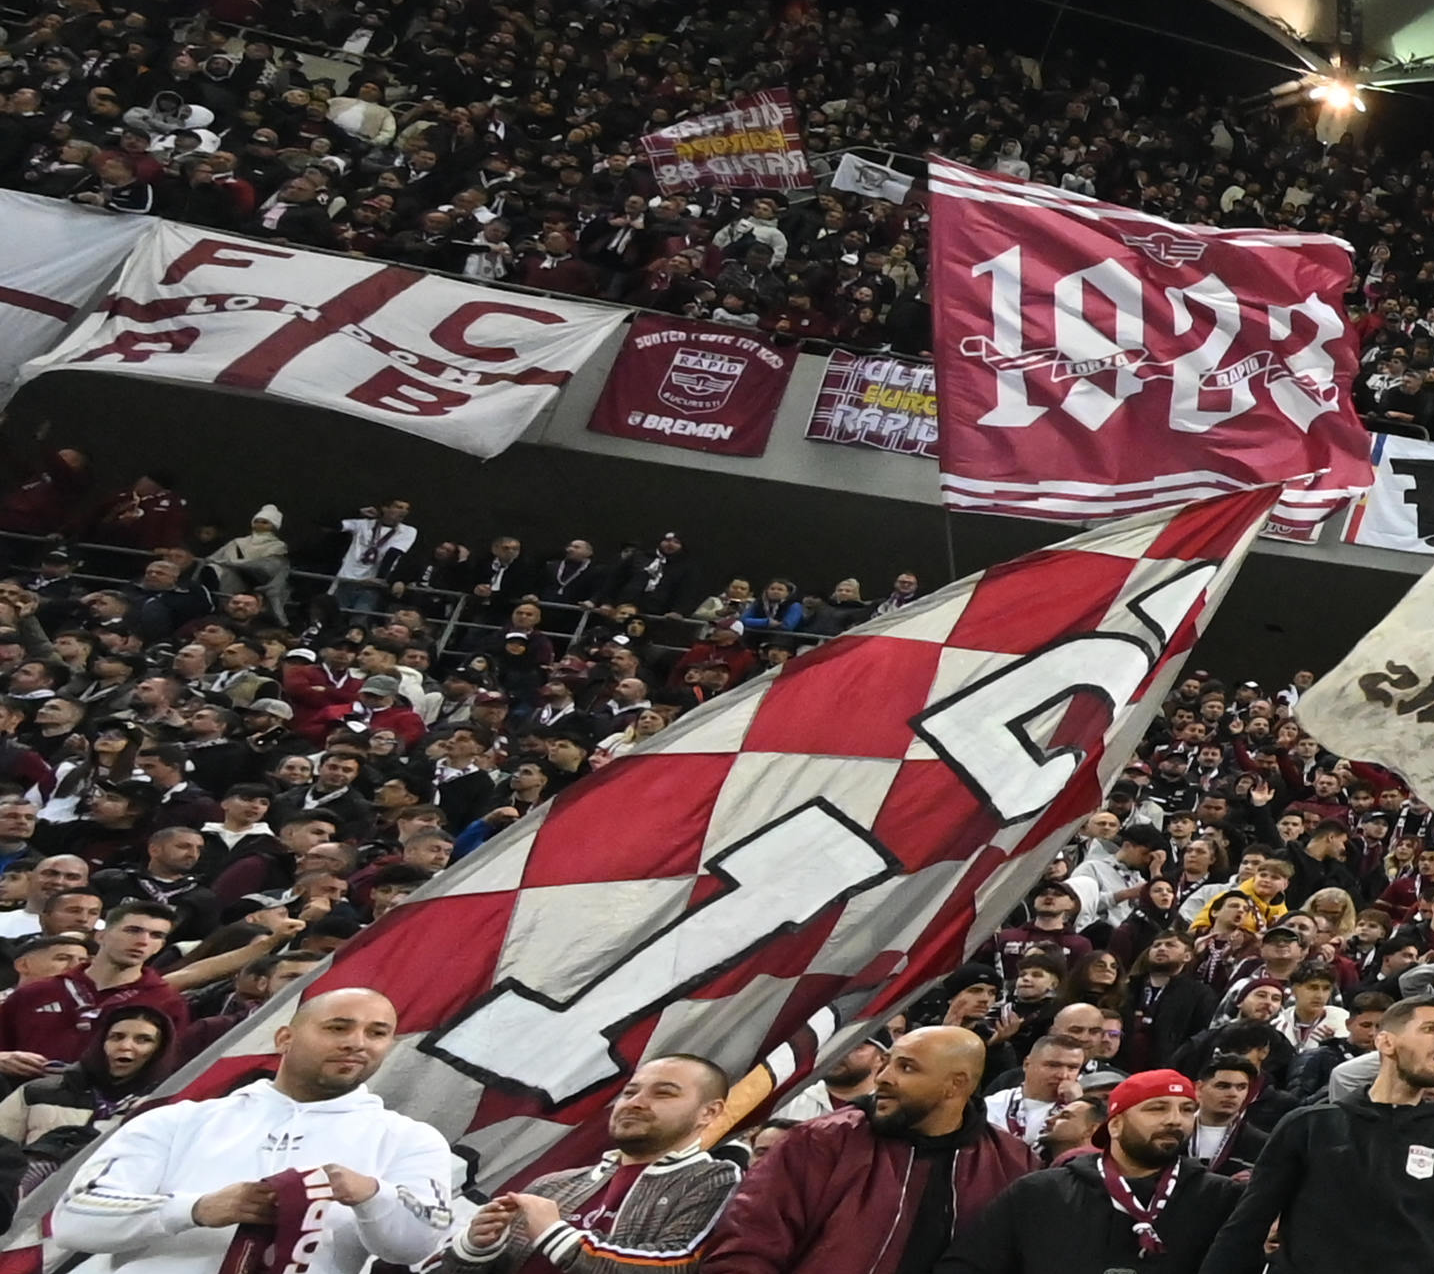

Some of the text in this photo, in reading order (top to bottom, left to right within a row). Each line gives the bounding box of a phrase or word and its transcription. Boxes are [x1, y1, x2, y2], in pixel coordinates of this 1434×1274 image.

[971, 245, 1344, 434] 1923
[679, 355, 738, 374] RAPID
[1216, 359, 1260, 388] RAPID
[642, 414, 733, 441] BREMEN
